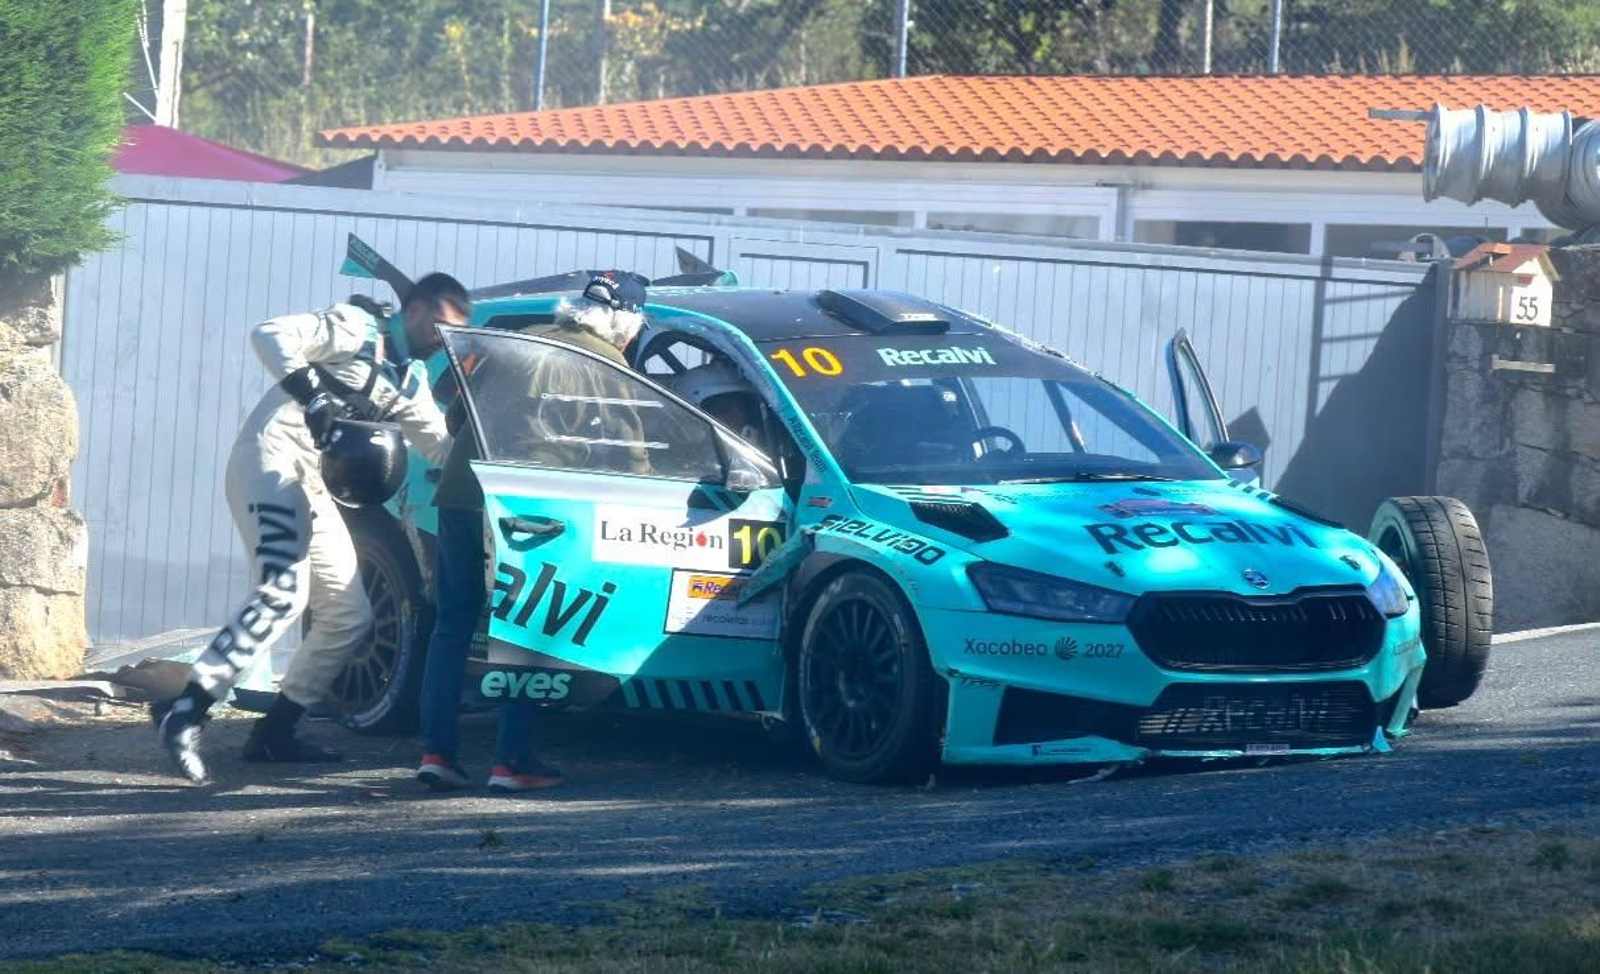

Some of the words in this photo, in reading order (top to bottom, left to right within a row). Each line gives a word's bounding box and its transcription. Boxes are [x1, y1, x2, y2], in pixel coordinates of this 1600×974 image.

[1516, 296, 1539, 321] 55
[771, 346, 844, 377] 10
[876, 346, 997, 367] Recalvi
[601, 520, 632, 542] La
[733, 524, 782, 565] 10
[1083, 519, 1321, 555] Recalvi
[964, 637, 1048, 657] Xacobeo
[1085, 643, 1125, 659] 2027
[481, 669, 572, 700] eyes
